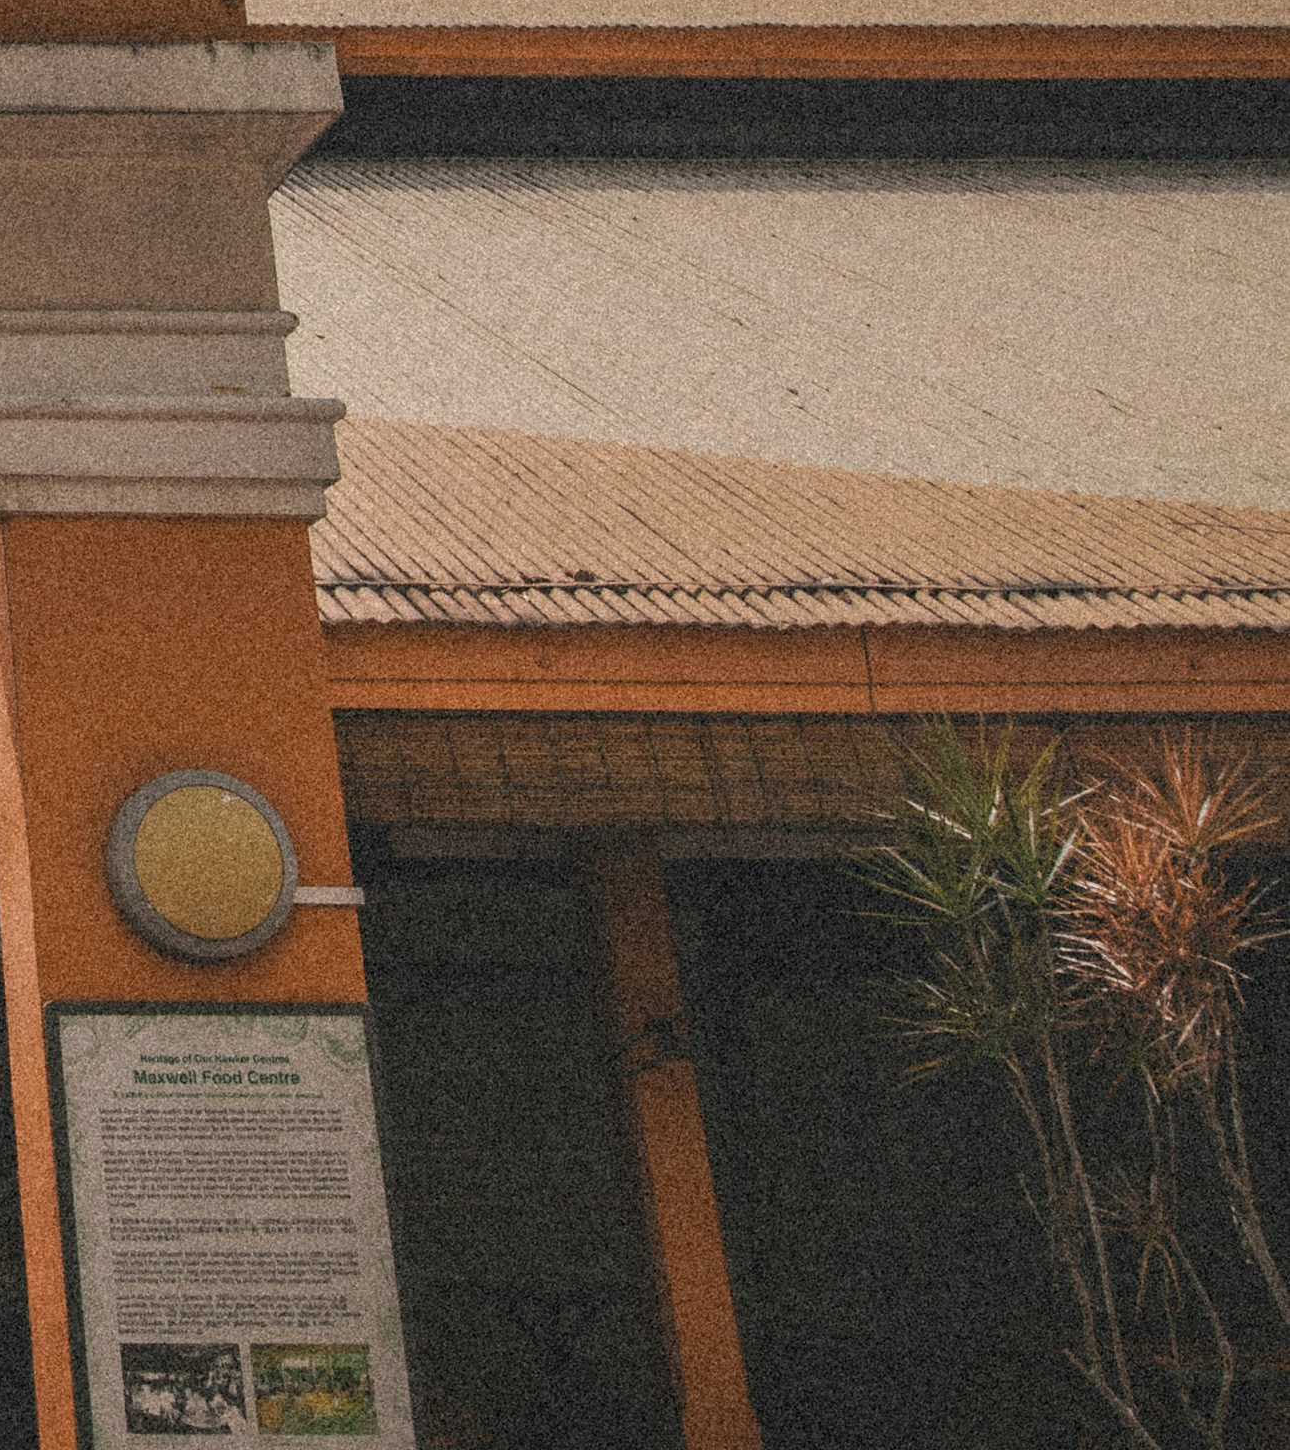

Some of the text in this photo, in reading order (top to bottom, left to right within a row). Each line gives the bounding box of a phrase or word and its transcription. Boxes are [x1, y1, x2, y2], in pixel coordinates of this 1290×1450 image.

[133, 1070, 301, 1085] Maxwell Food Centre
